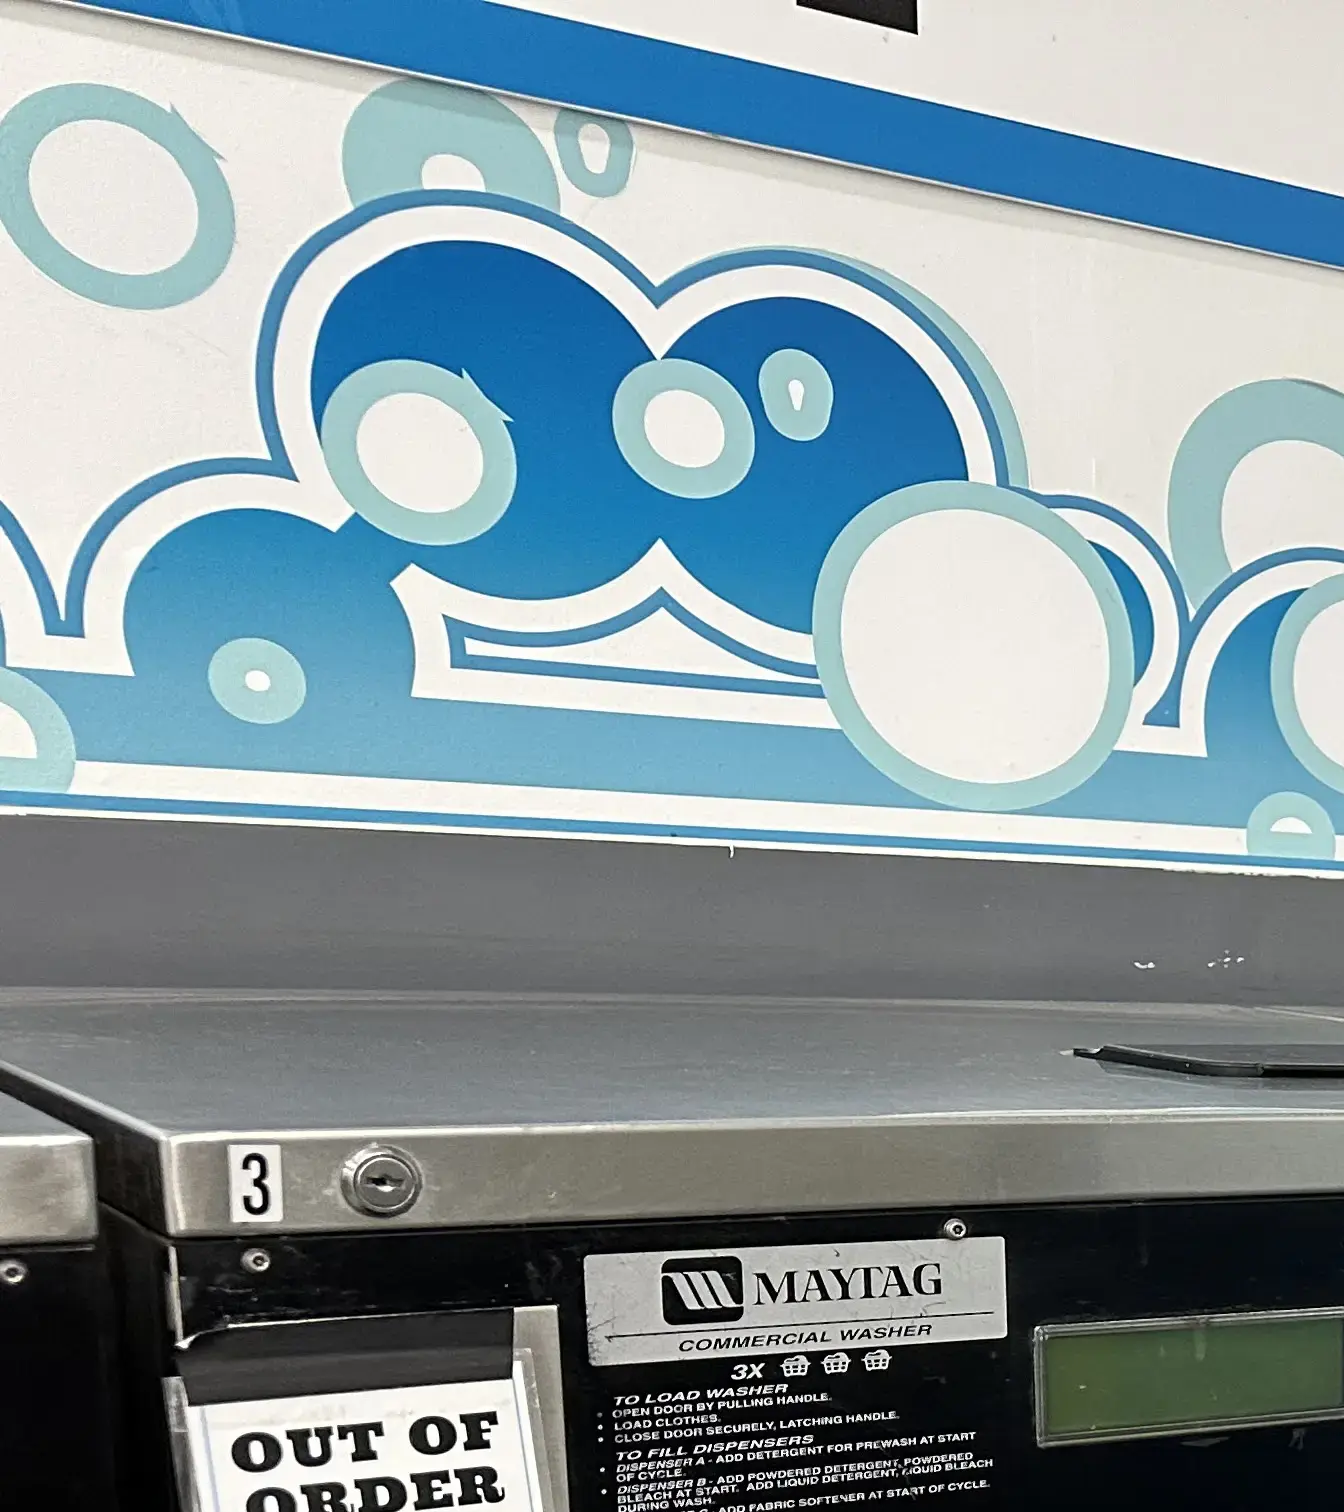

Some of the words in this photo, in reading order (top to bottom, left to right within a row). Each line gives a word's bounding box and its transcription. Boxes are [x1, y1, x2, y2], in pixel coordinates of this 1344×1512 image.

[241, 1153, 271, 1216] 3
[752, 1262, 943, 1307] MAYTAG
[679, 1332, 832, 1352] COMMERCIAL
[840, 1324, 932, 1342] WASHER
[731, 1362, 766, 1380] 3X
[613, 1406, 650, 1418] OPEN
[654, 1403, 693, 1414] DOOR
[697, 1402, 714, 1411] BY
[718, 1397, 773, 1409] PULLING
[777, 1393, 832, 1404] HANDLE.
[614, 1395, 640, 1405] TO
[646, 1390, 700, 1403] LOAD
[707, 1384, 788, 1399] WASHER
[615, 1419, 652, 1430] LOAD
[656, 1414, 721, 1427] CLOTHES.
[615, 1431, 660, 1443] CLOSE
[664, 1427, 703, 1438] DOOR
[706, 1421, 776, 1435] SECURELY,
[780, 1416, 842, 1428] LATCHING
[846, 1411, 899, 1423] HANDLE.
[231, 1420, 384, 1474] OUT
[408, 1410, 500, 1456] OF
[616, 1449, 642, 1460] TO
[648, 1446, 688, 1458] FILL
[693, 1435, 814, 1454] DISPENSERS
[617, 1457, 693, 1472] DISPENSER
[695, 1456, 705, 1465] A
[716, 1453, 743, 1463] ADD
[747, 1445, 824, 1460] DETERGENT
[827, 1443, 852, 1453] FOR
[856, 1437, 916, 1451] PREWASH
[920, 1436, 934, 1445] AT
[938, 1432, 976, 1443] START
[616, 1472, 635, 1482] OF
[638, 1468, 686, 1480] CYCLE.
[618, 1479, 693, 1494] DISPENSER
[697, 1477, 706, 1486] B
[717, 1474, 744, 1484] ADD
[748, 1467, 821, 1481] POWDERED
[904, 1452, 973, 1466] POWDERED
[618, 1490, 672, 1504] BLEACH
[676, 1488, 692, 1498] AT
[696, 1484, 739, 1496] START.
[747, 1480, 773, 1491] ADD
[777, 1476, 819, 1488] LIQUID
[945, 1459, 993, 1471] BLEACH
[618, 1501, 669, 1512] DURING
[749, 1500, 795, 1512] FABRIC
[799, 1492, 865, 1507] SOFTENER
[869, 1491, 884, 1500] AT
[887, 1486, 925, 1498] START
[929, 1484, 945, 1493] OF
[948, 1480, 990, 1491] CYCLE.
